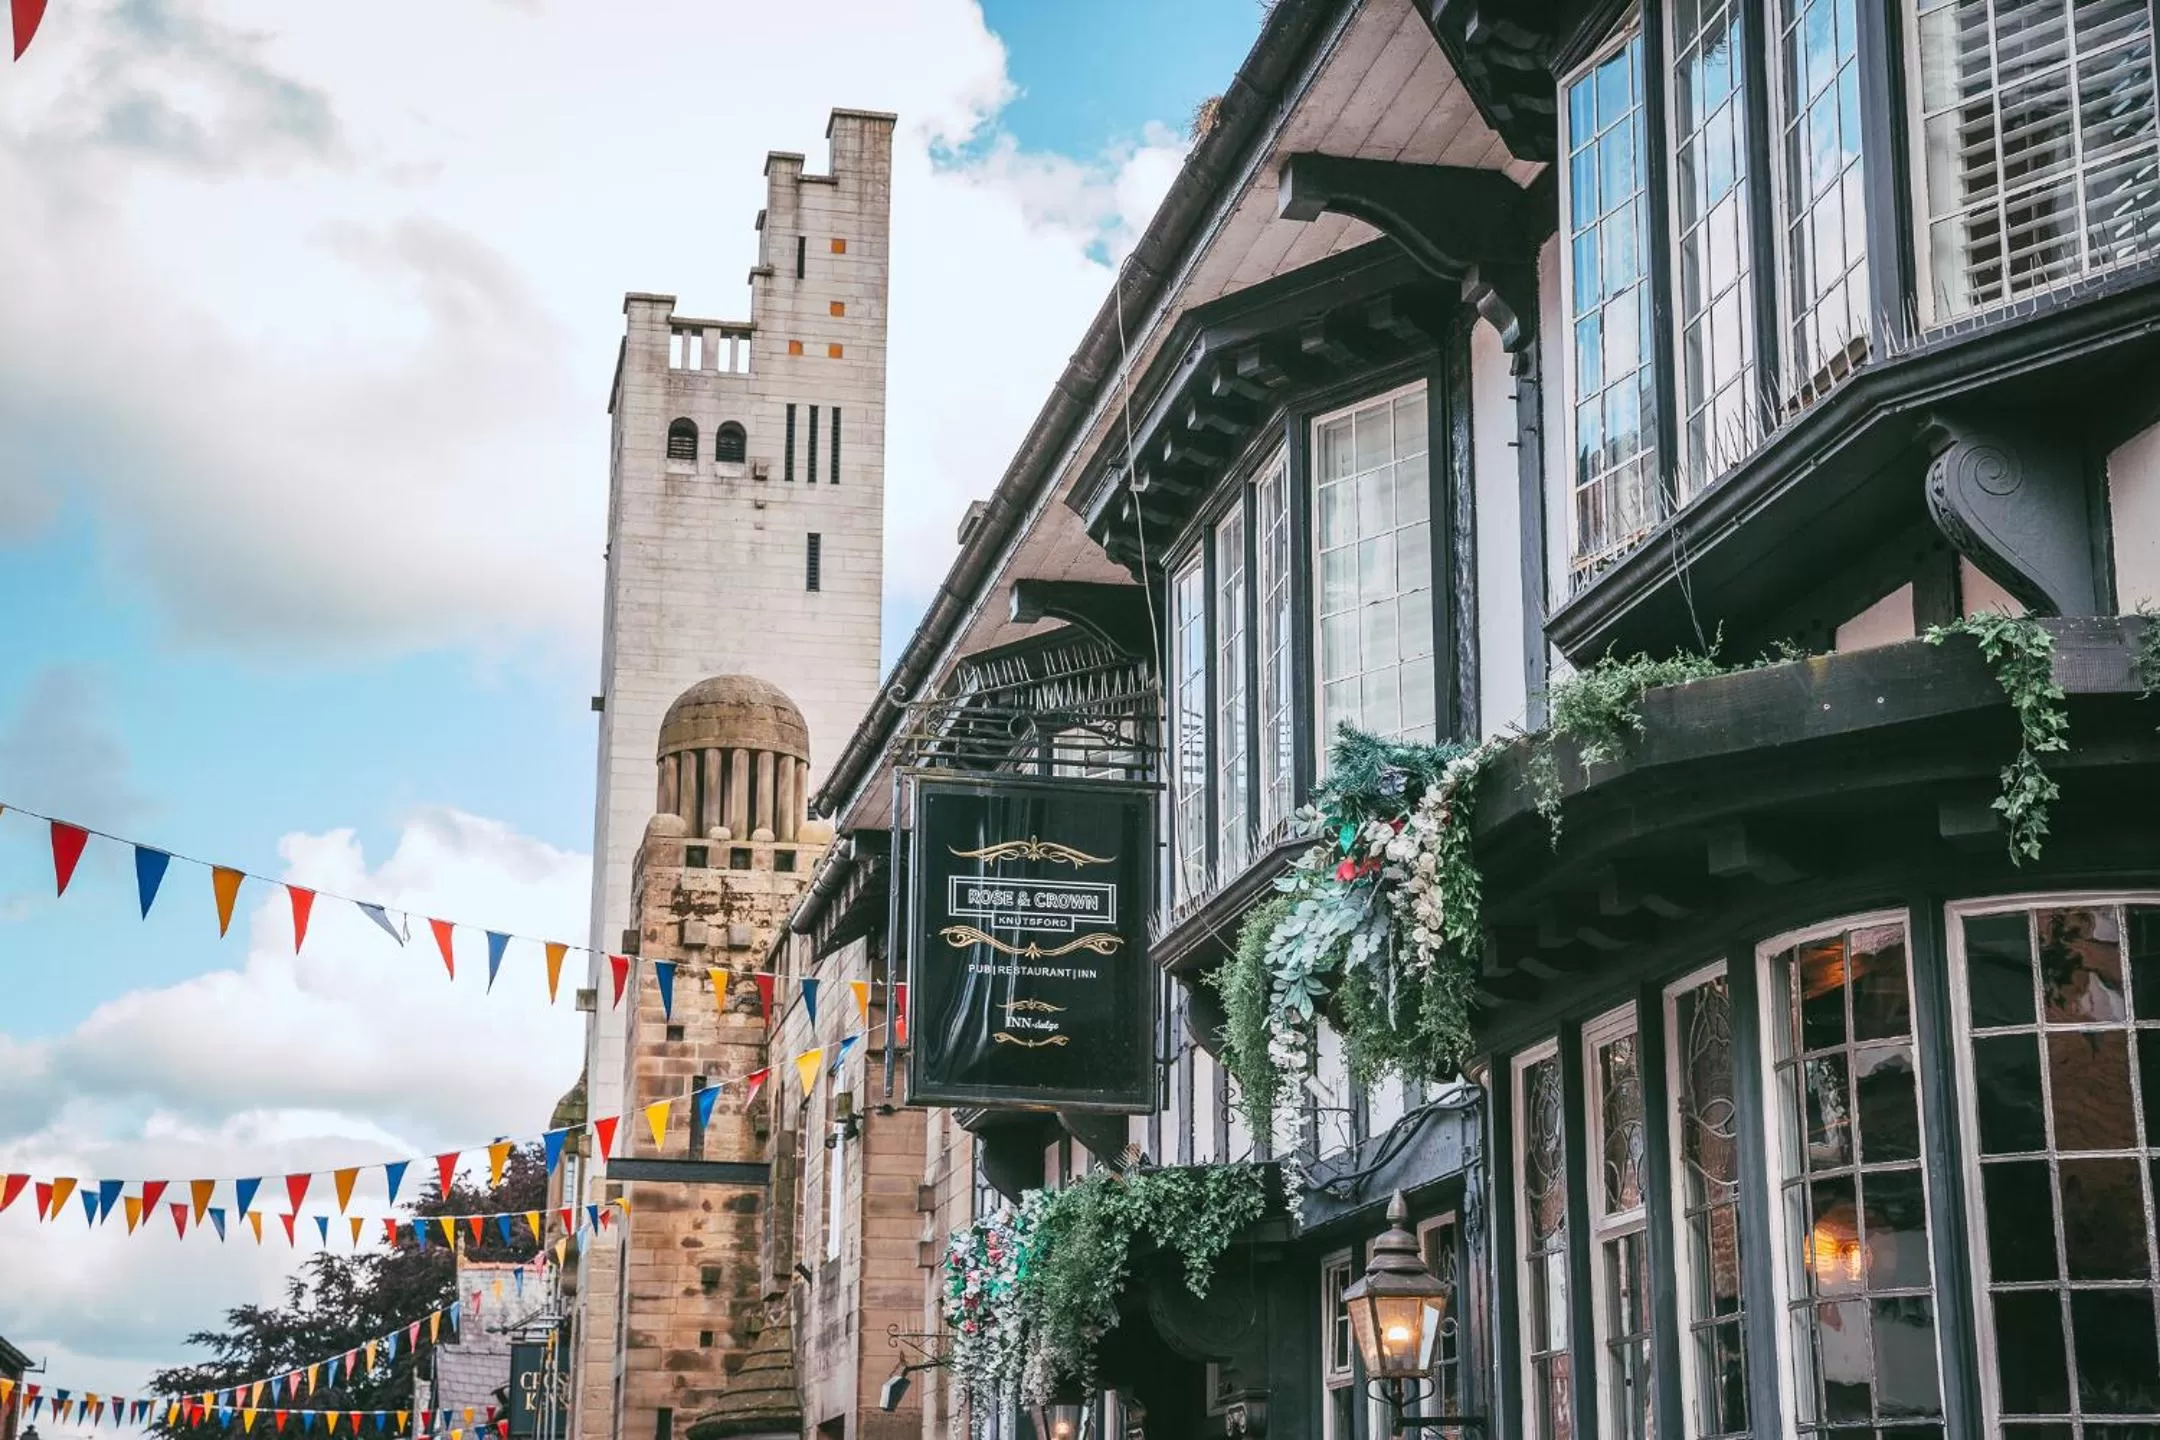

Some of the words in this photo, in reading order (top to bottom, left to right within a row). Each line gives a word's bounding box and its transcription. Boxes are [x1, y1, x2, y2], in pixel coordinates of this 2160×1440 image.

[968, 888, 1014, 907] ROSE
[1017, 890, 1031, 907] &
[1034, 892, 1099, 911] CROWN
[998, 915, 1068, 927] KNUTSFORD
